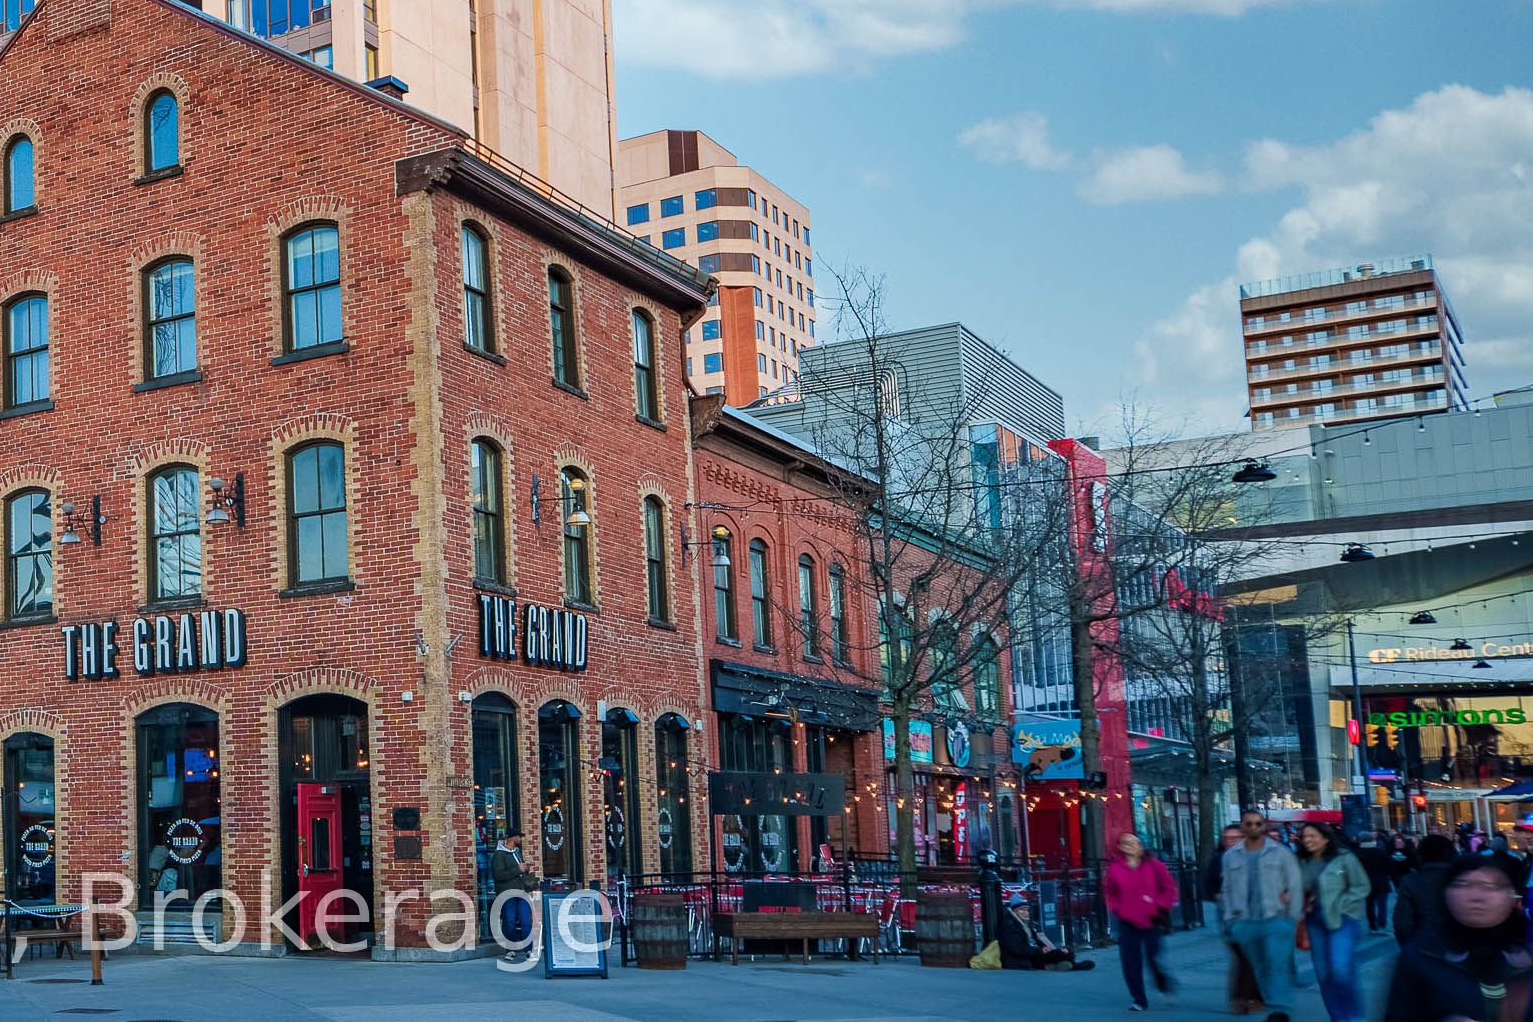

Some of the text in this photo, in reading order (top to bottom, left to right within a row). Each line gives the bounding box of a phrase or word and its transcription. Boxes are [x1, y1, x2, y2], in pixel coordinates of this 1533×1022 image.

[61, 607, 242, 678] THE GRAND
[480, 594, 587, 667] THE GRAND
[1368, 642, 1533, 663] CF Rideau Cent
[1389, 707, 1527, 727] simons
